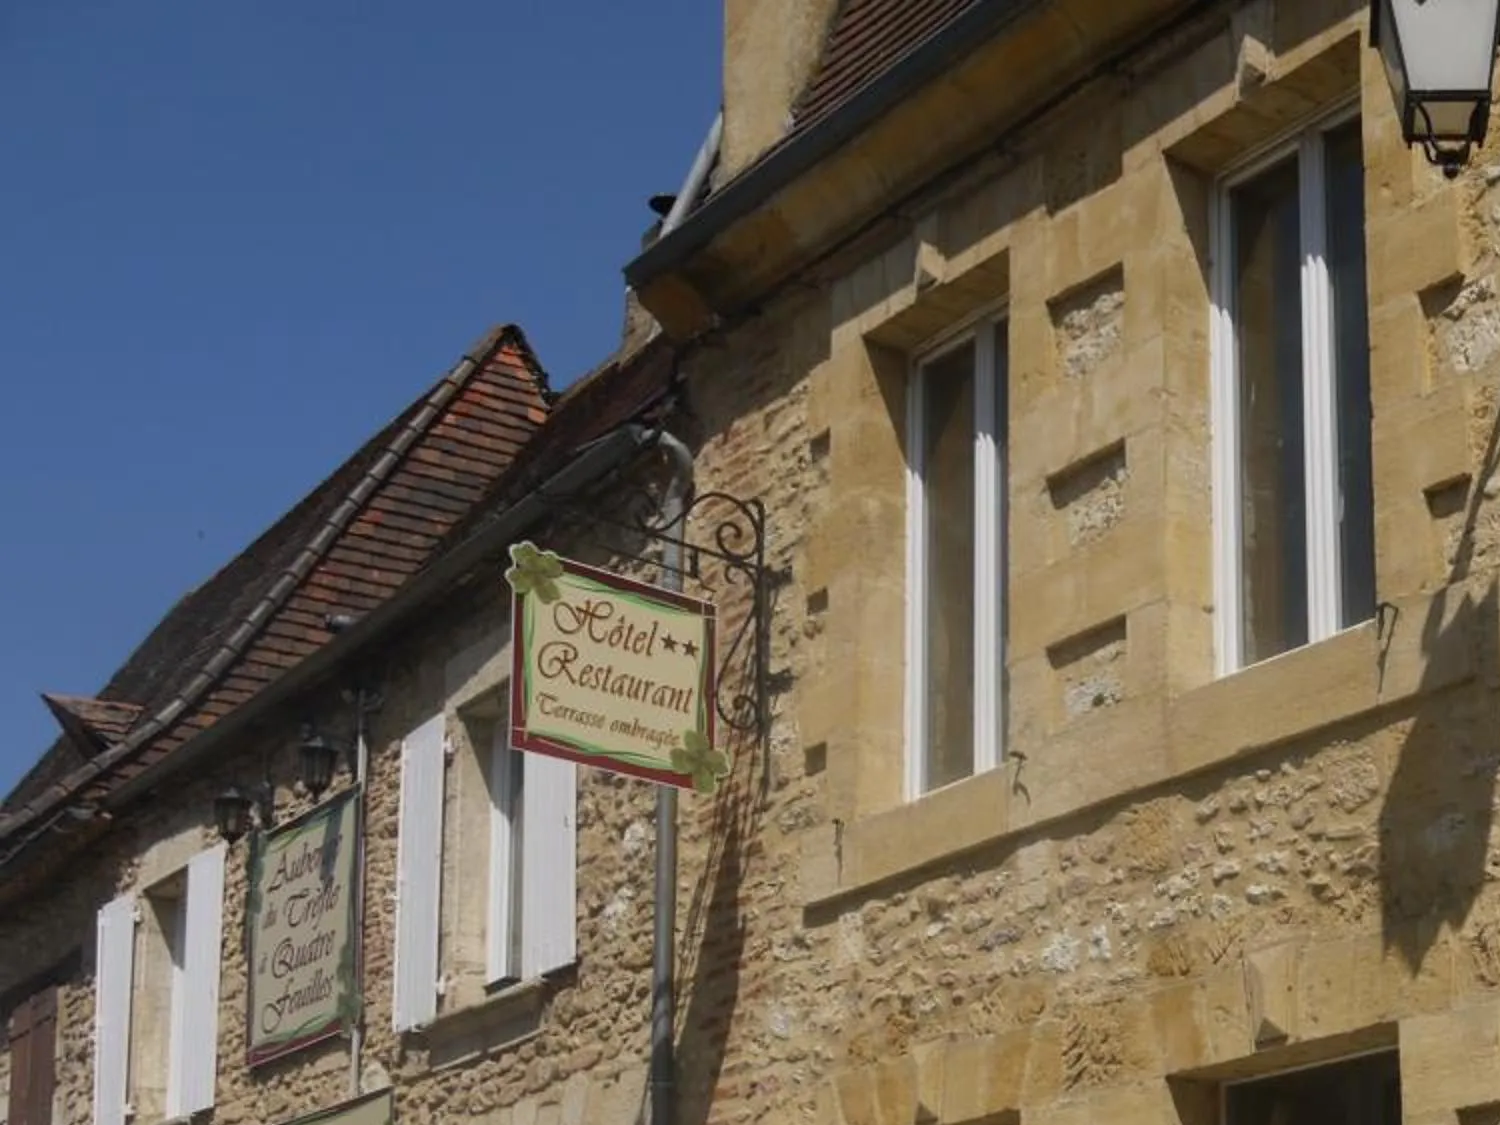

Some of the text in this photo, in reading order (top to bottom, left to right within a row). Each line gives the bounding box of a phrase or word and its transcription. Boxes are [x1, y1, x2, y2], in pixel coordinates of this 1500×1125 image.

[553, 600, 659, 657] Hôtel
[537, 641, 694, 715] Restaurant
[536, 692, 605, 730] Terrasse
[266, 834, 342, 894] Aube
[272, 929, 335, 980] Quatre
